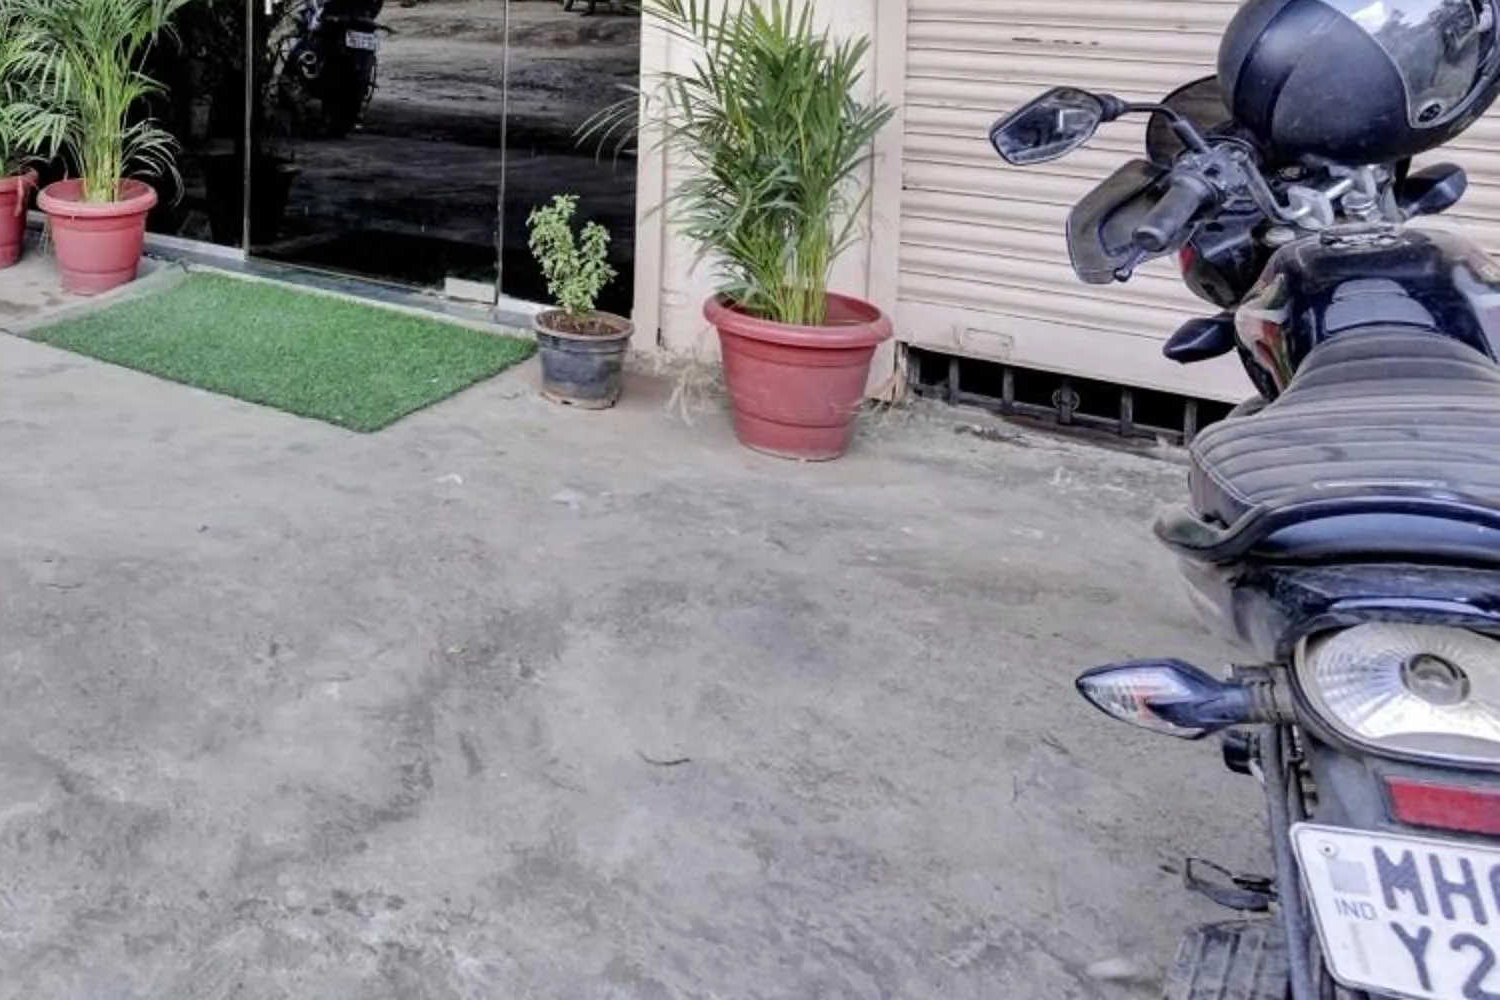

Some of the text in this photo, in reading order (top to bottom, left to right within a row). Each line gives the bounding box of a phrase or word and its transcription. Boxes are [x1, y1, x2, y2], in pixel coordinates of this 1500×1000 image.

[1333, 897, 1378, 921] IND
[1372, 844, 1500, 926] MH
[1389, 920, 1497, 1000] Y2
